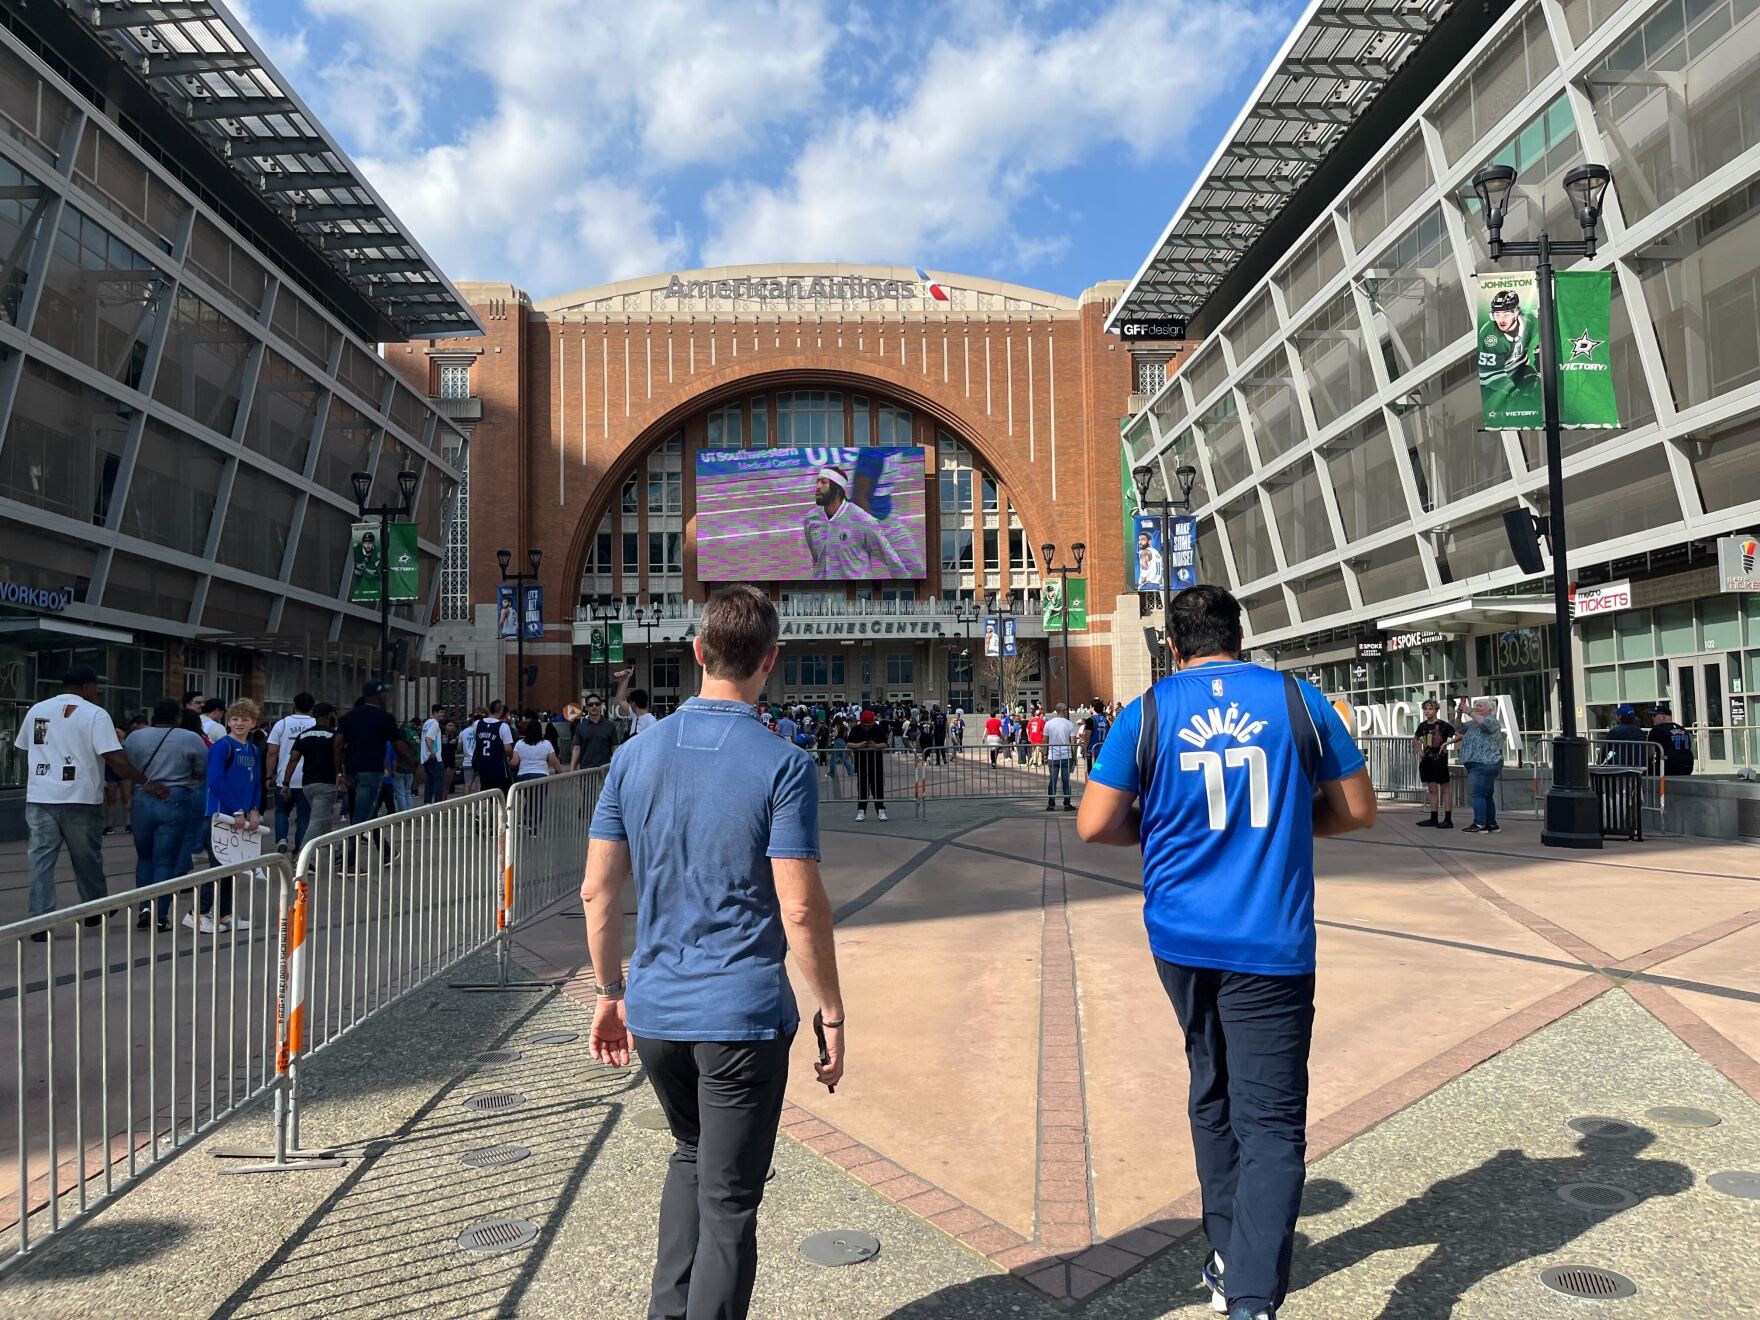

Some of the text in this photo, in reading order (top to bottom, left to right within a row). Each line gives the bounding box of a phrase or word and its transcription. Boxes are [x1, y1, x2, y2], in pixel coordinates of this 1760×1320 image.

[665, 274, 915, 299] American Airlines
[1481, 279, 1532, 290] JOHNSTON
[1559, 363, 1604, 371] VICTORY
[1175, 523, 1190, 535] MAKE
[1173, 535, 1192, 551] SOME
[1172, 550, 1193, 568] NOISE!
[1578, 593, 1628, 613] TICKETS
[782, 620, 942, 635] AIRLINES CENTER
[1398, 632, 1422, 649] SPOKE
[1177, 702, 1268, 748] DONČIĆ
[482, 740, 491, 756] 2
[1179, 746, 1269, 830] 77
